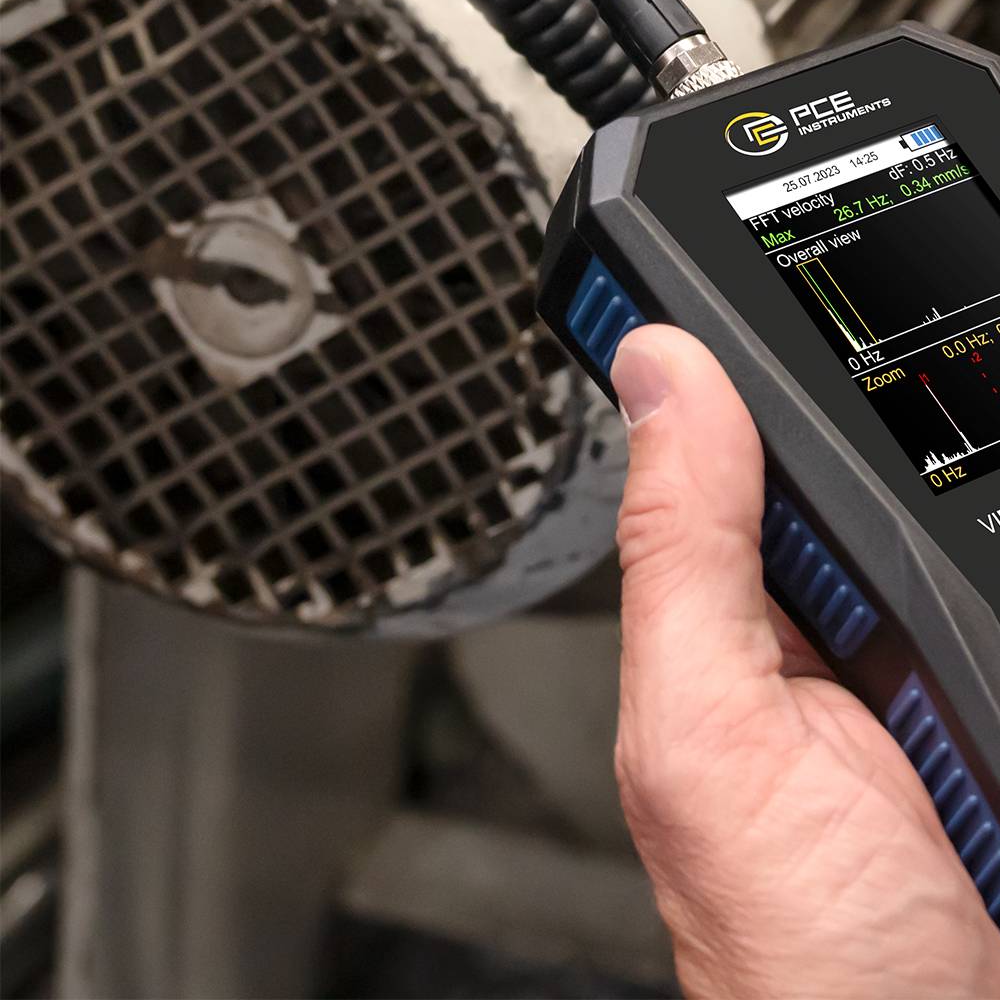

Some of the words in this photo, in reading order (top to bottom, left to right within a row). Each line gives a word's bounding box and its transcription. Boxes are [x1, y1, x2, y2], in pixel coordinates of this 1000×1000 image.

[789, 90, 855, 126] PCE
[798, 97, 892, 136] INSTRUMENTS
[782, 165, 841, 193] 25.07.2023
[849, 151, 879, 169] 14:25
[888, 165, 912, 181] dF:
[912, 154, 936, 172] 0.5
[935, 147, 958, 163] Hz
[748, 209, 780, 231] FFT
[781, 192, 835, 219] velocity
[760, 229, 797, 249] Max
[833, 200, 865, 222] 26.7
[865, 193, 894, 210] Hz;
[899, 176, 932, 198] 0.34
[932, 164, 971, 189] mm/s
[776, 239, 829, 268] Overall
[828, 229, 861, 249] view
[847, 357, 861, 371] 0
[859, 350, 885, 366] Hz
[941, 340, 967, 359] 0.0
[965, 332, 995, 349] Hz;
[861, 367, 906, 392] Zoom
[929, 473, 943, 488] 0
[941, 465, 967, 482] Hz
